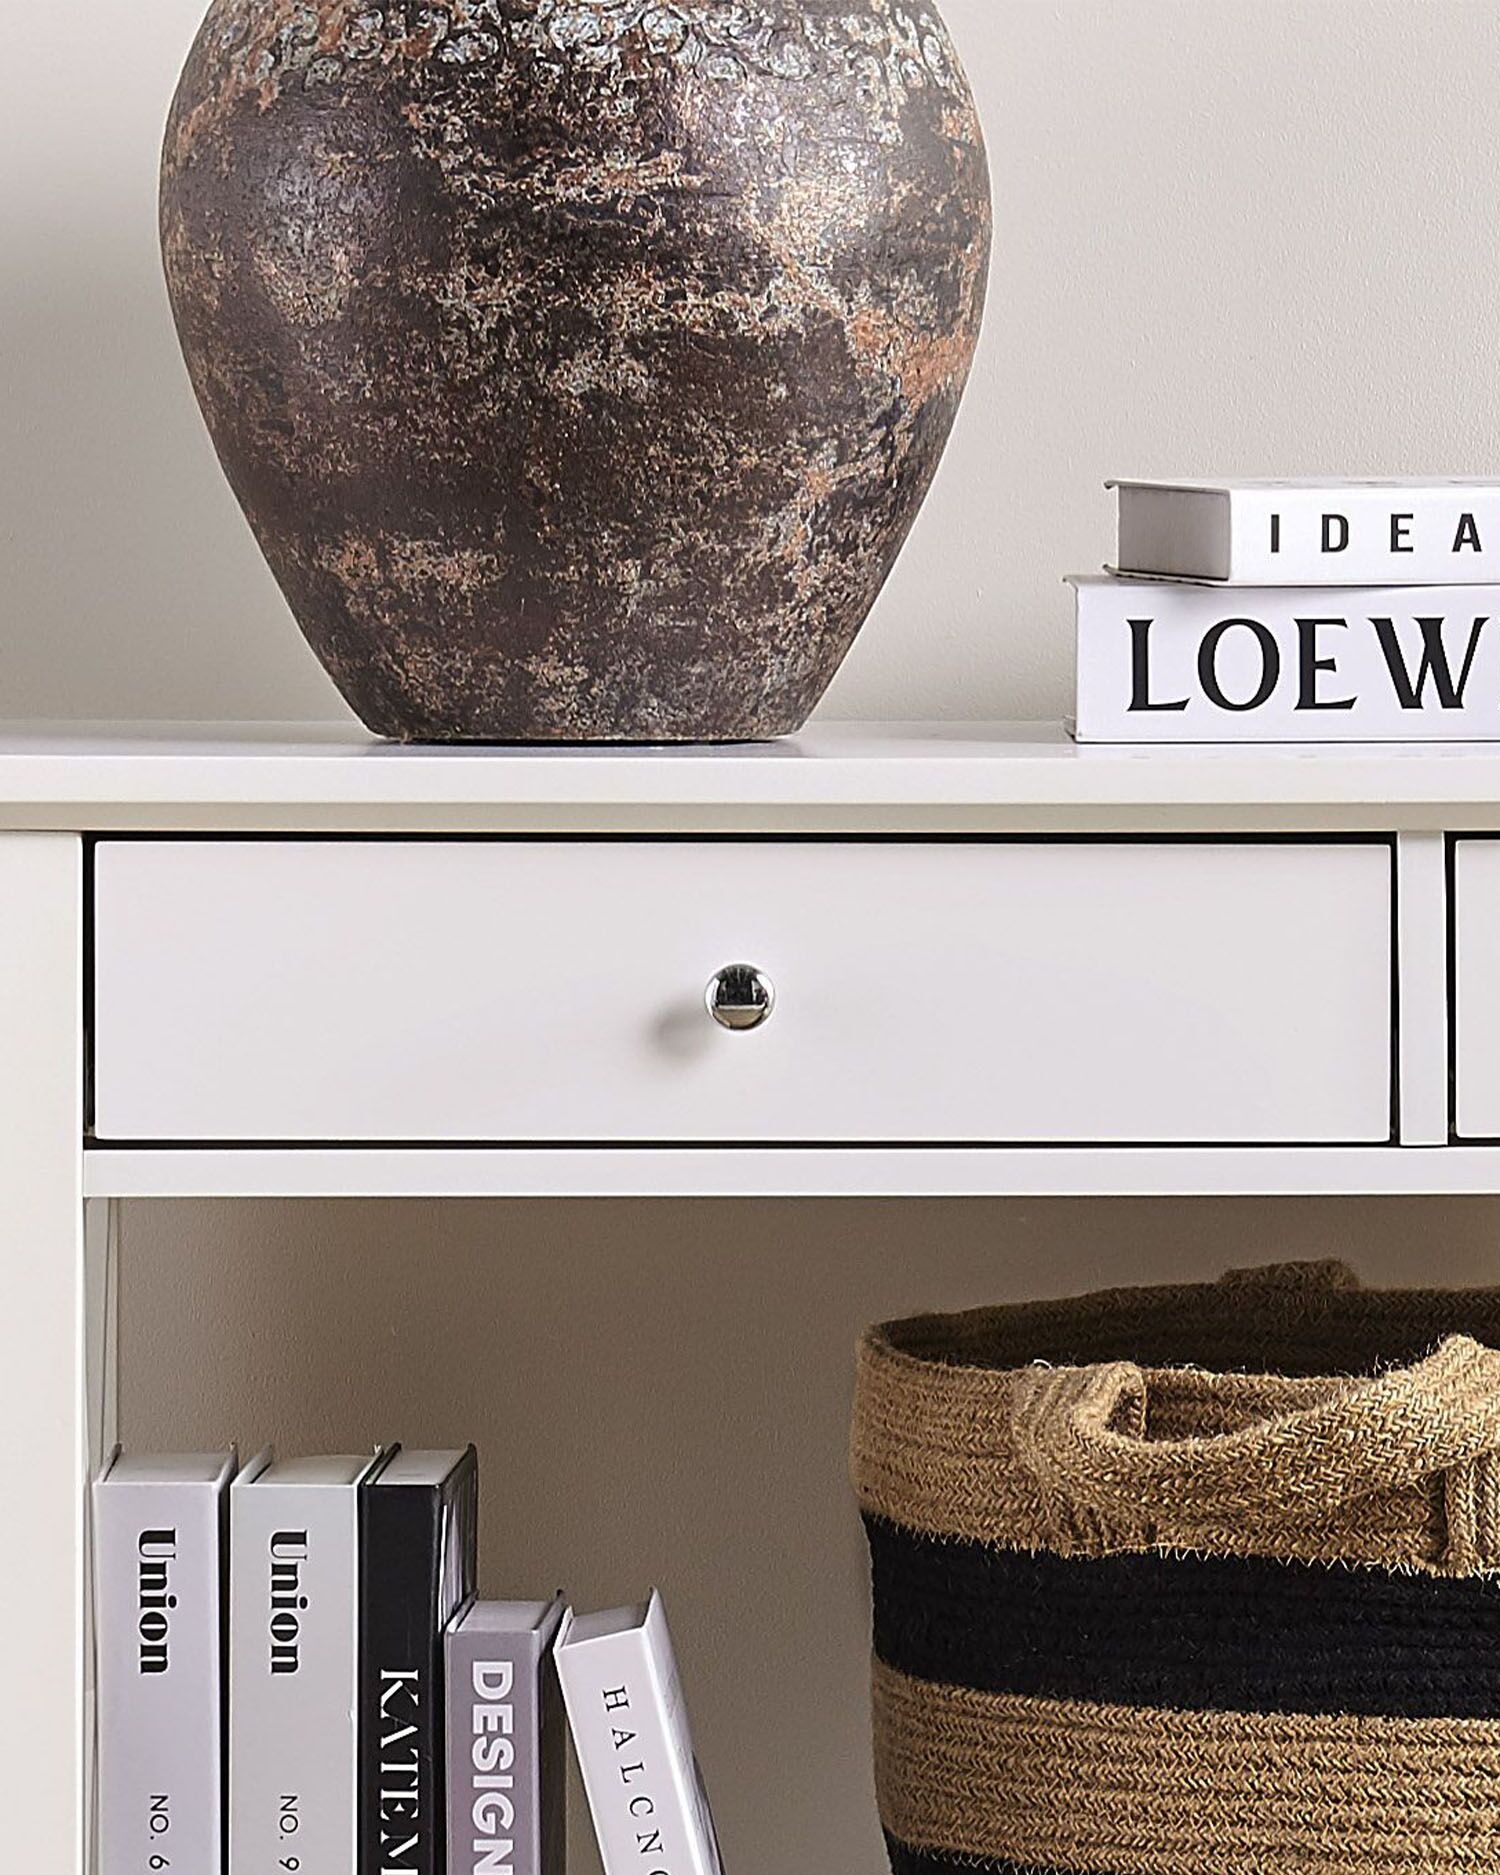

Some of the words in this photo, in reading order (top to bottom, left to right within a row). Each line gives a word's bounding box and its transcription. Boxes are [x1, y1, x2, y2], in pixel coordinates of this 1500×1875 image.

[1270, 512, 1483, 554] IDEA
[139, 1528, 177, 1674] Union
[270, 1530, 308, 1674] Union
[380, 1669, 418, 1820] KATE
[150, 1795, 169, 1840] NO.
[280, 1796, 298, 1840] NO.
[149, 1855, 170, 1869] 6
[279, 1857, 299, 1871] 9
